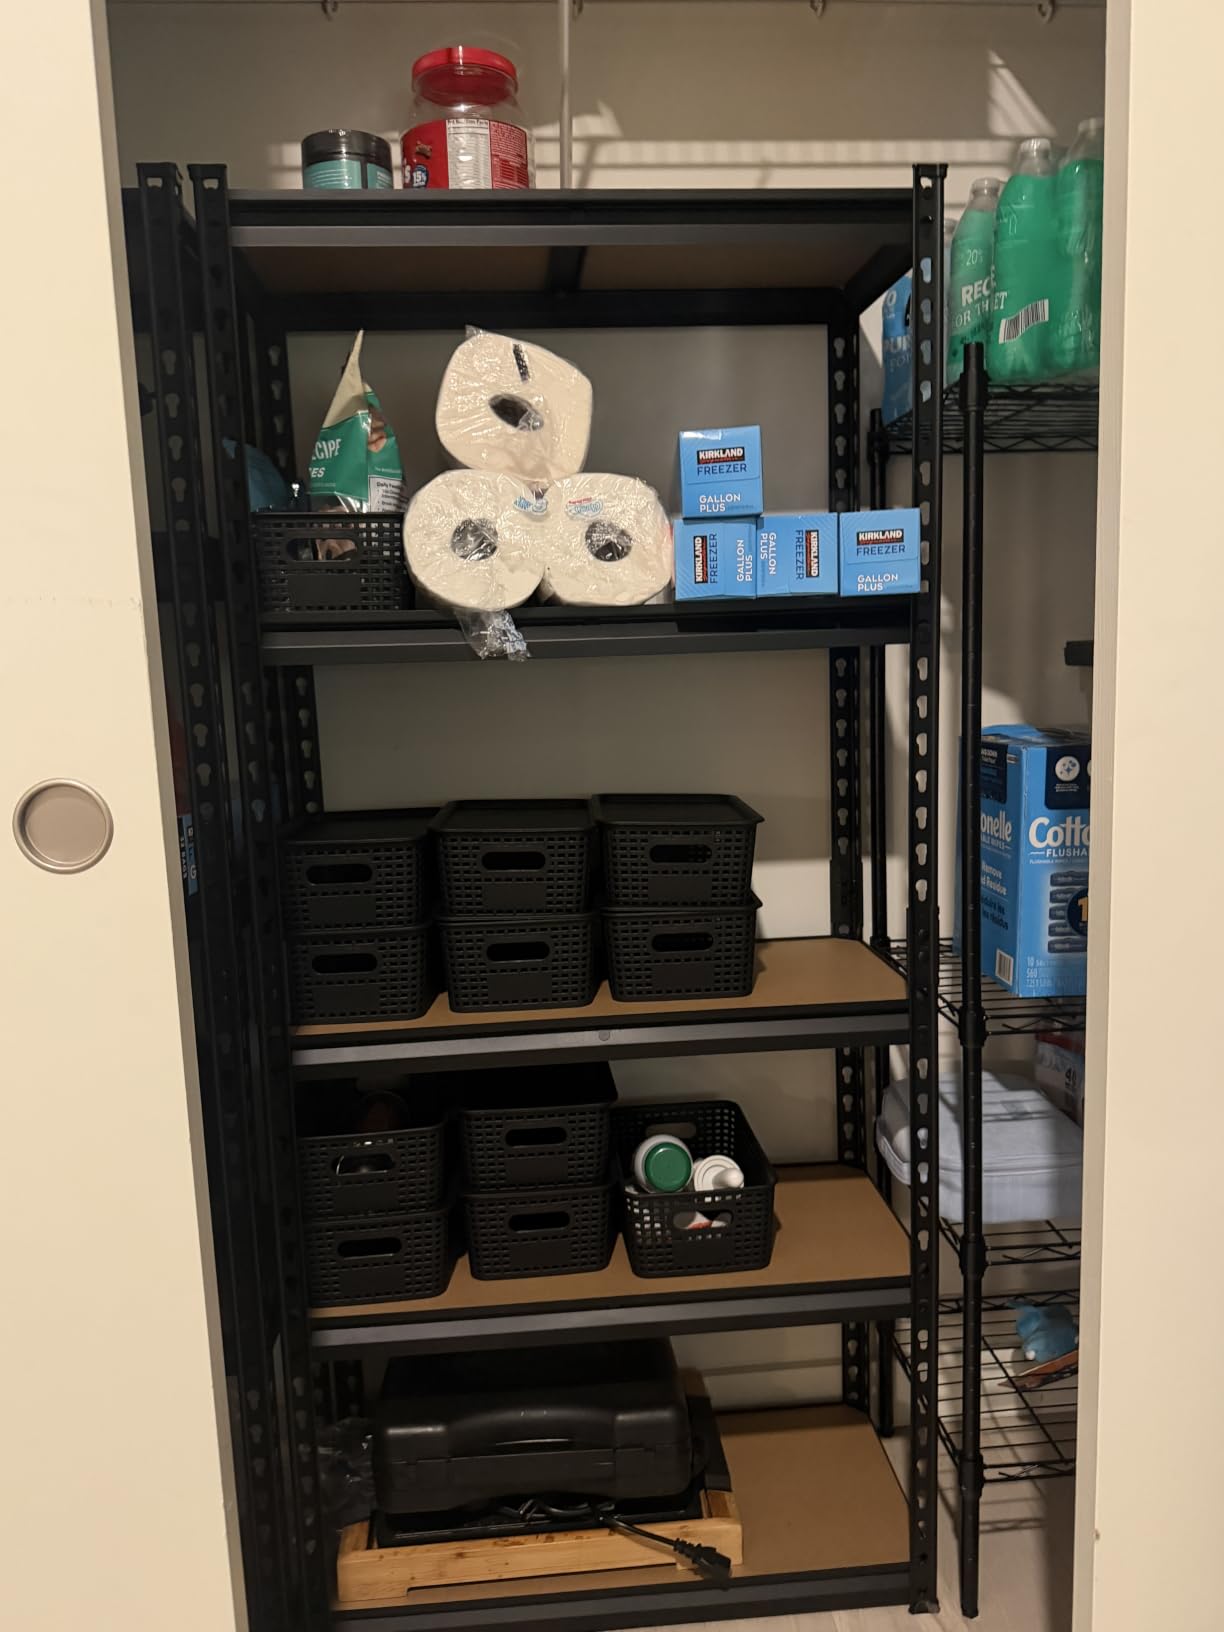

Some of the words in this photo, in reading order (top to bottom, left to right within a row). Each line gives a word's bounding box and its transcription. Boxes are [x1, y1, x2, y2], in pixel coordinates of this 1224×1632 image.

[698, 447, 744, 461] KIRKLAND
[697, 463, 747, 476] FREEZER
[699, 493, 741, 504] GALLON
[699, 503, 726, 513] PLUS
[858, 530, 903, 542] KIRKLAND
[760, 533, 768, 560] PLUS
[768, 532, 777, 575] GALLON
[795, 529, 805, 580] FREEZER
[810, 531, 819, 577] KIRKLAND
[856, 544, 906, 557] FREEZER
[694, 536, 703, 582] KIRKLAND
[709, 533, 718, 584] FREEZER
[736, 539, 745, 582] GALLON
[745, 554, 753, 581] PLUS
[857, 573, 899, 584] GALLON
[857, 582, 884, 592] PLUS
